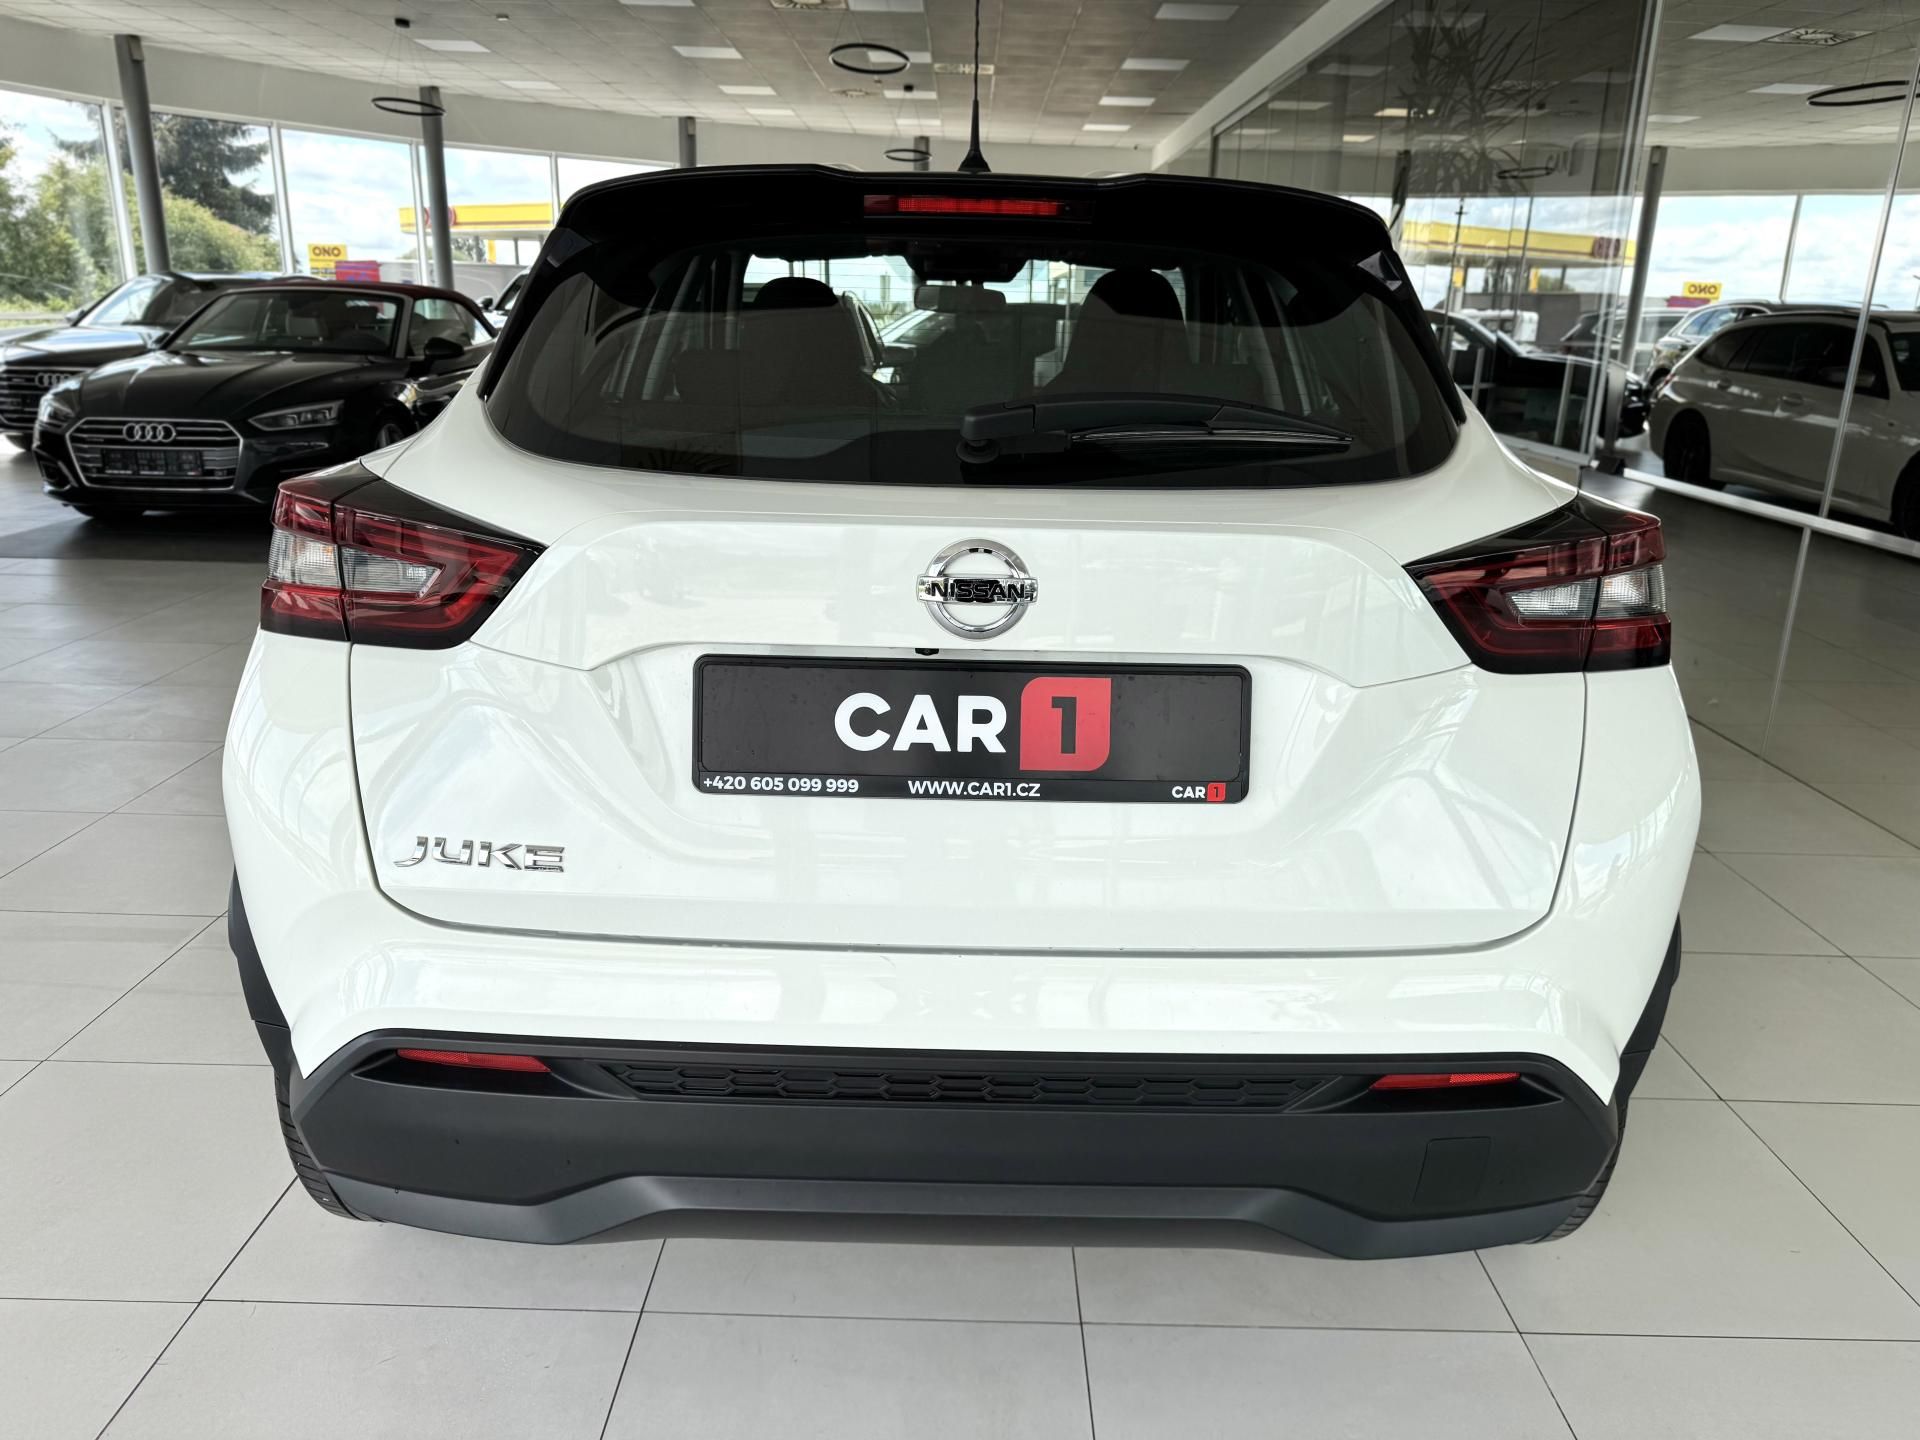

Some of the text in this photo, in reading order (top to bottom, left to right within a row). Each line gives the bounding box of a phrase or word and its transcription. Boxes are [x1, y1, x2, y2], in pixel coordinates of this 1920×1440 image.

[312, 246, 342, 257] ONO
[930, 581, 1025, 600] NISSAN
[703, 776, 859, 793] +420 605 099 999
[908, 780, 1041, 797] WWW.CAR1.CZ
[393, 836, 565, 873] JUKE
